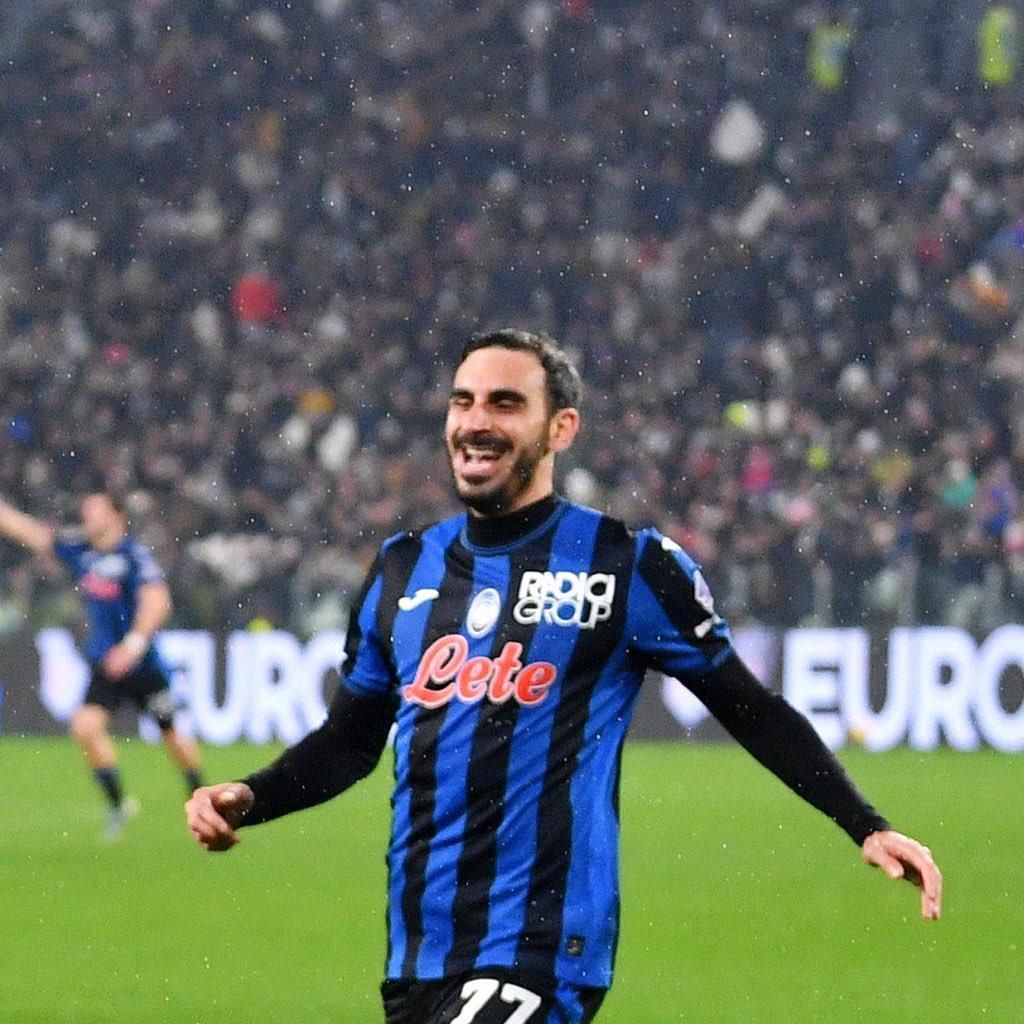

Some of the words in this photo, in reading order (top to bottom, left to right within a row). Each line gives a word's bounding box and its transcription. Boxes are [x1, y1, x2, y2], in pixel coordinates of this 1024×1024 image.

[518, 571, 616, 604] RADICI
[513, 597, 612, 631] GROUP
[402, 634, 557, 709] Lete
